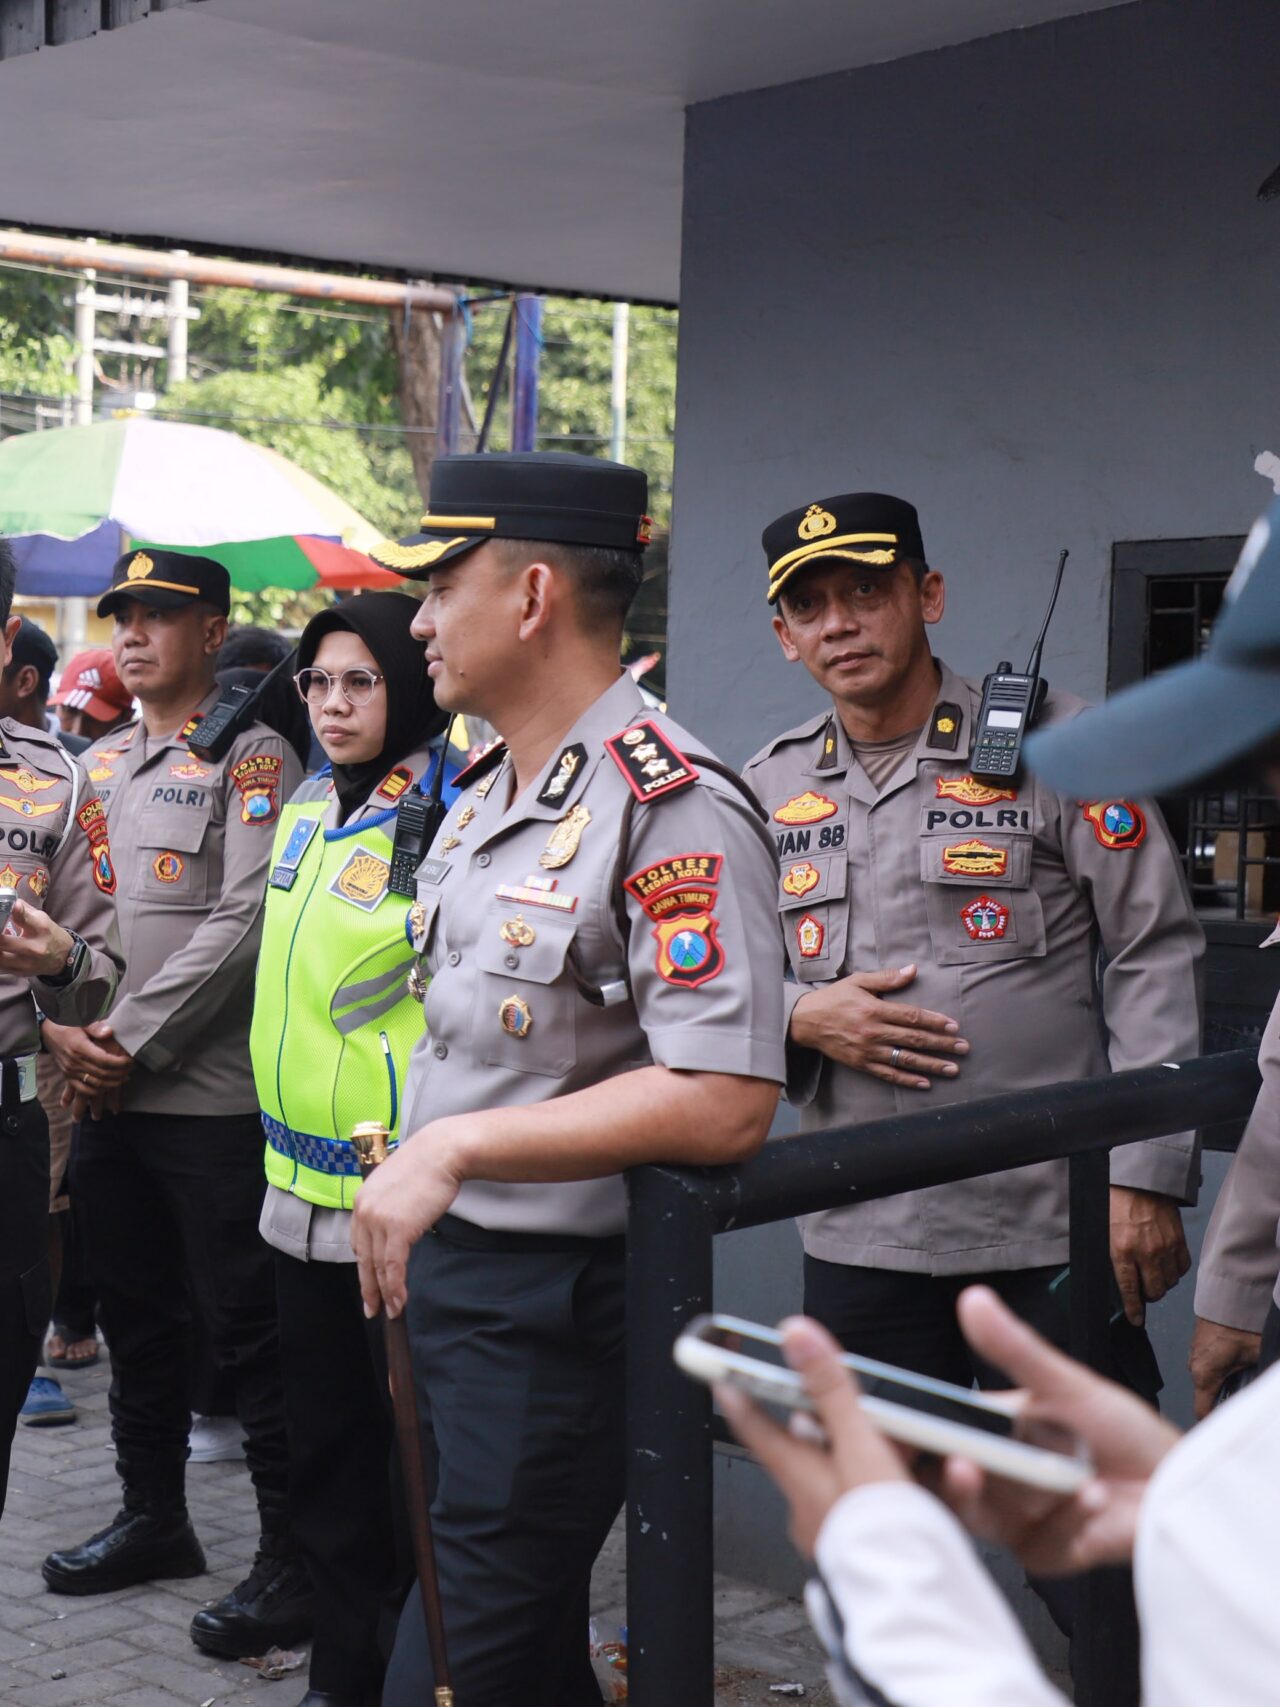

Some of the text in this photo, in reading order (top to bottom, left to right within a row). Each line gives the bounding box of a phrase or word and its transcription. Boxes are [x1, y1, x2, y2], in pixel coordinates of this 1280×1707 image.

[642, 767, 687, 793] POLISI
[152, 787, 206, 807] POLRI
[927, 809, 1029, 830] POLRI
[636, 858, 710, 889] POLRES
[642, 868, 707, 896] KEDIRI KOTA
[651, 892, 711, 915] JAWA TIMUR
